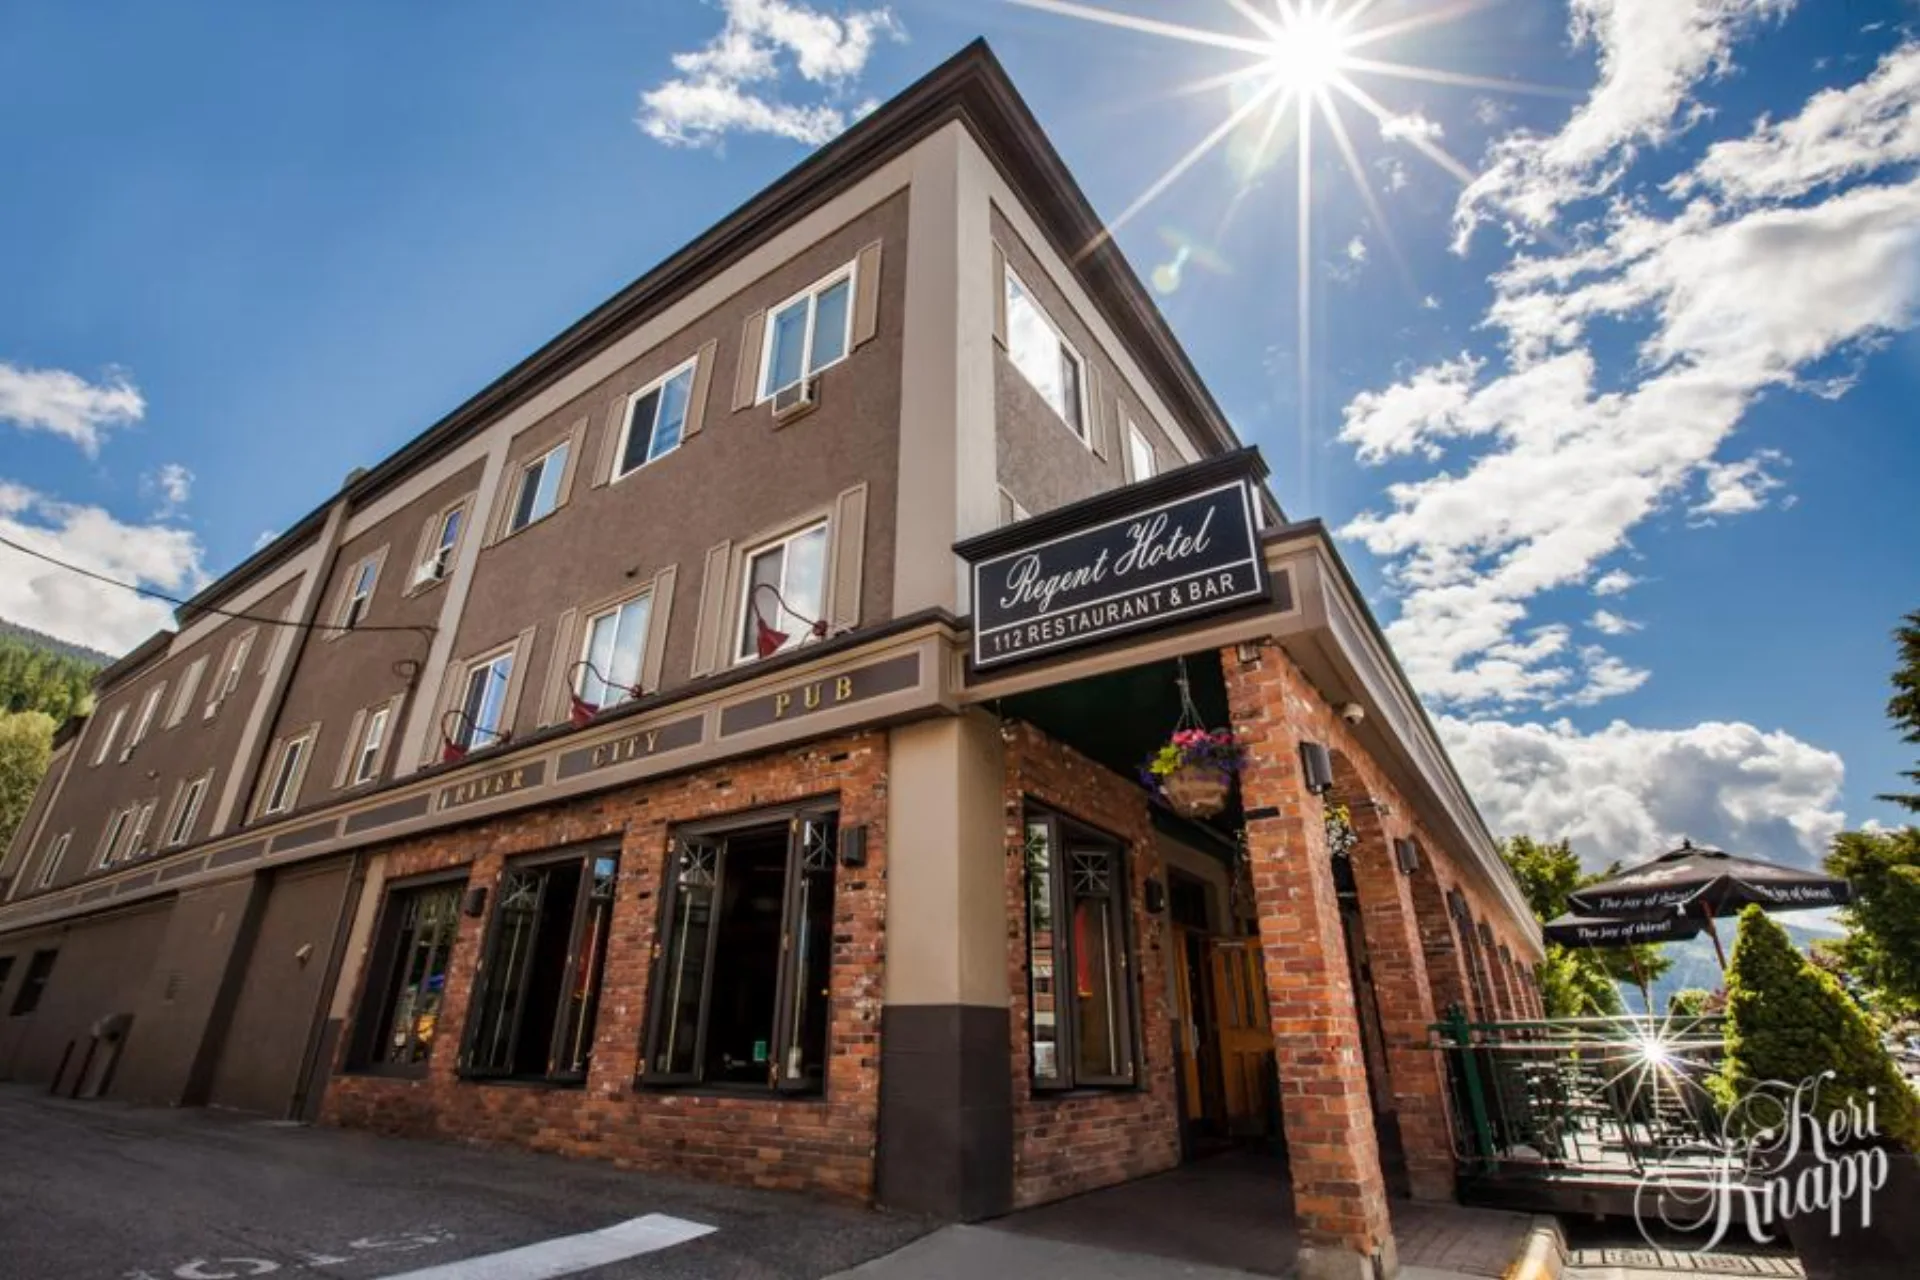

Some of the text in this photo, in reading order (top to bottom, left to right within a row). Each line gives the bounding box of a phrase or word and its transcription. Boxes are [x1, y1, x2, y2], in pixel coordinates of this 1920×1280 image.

[1000, 504, 1217, 613] Regent Hotel
[992, 572, 1236, 652] 112 RESTAURANT & BAR
[592, 729, 661, 766] CITY
[775, 676, 853, 718] PUB
[1577, 927, 1599, 938] The
[1621, 923, 1634, 936] of
